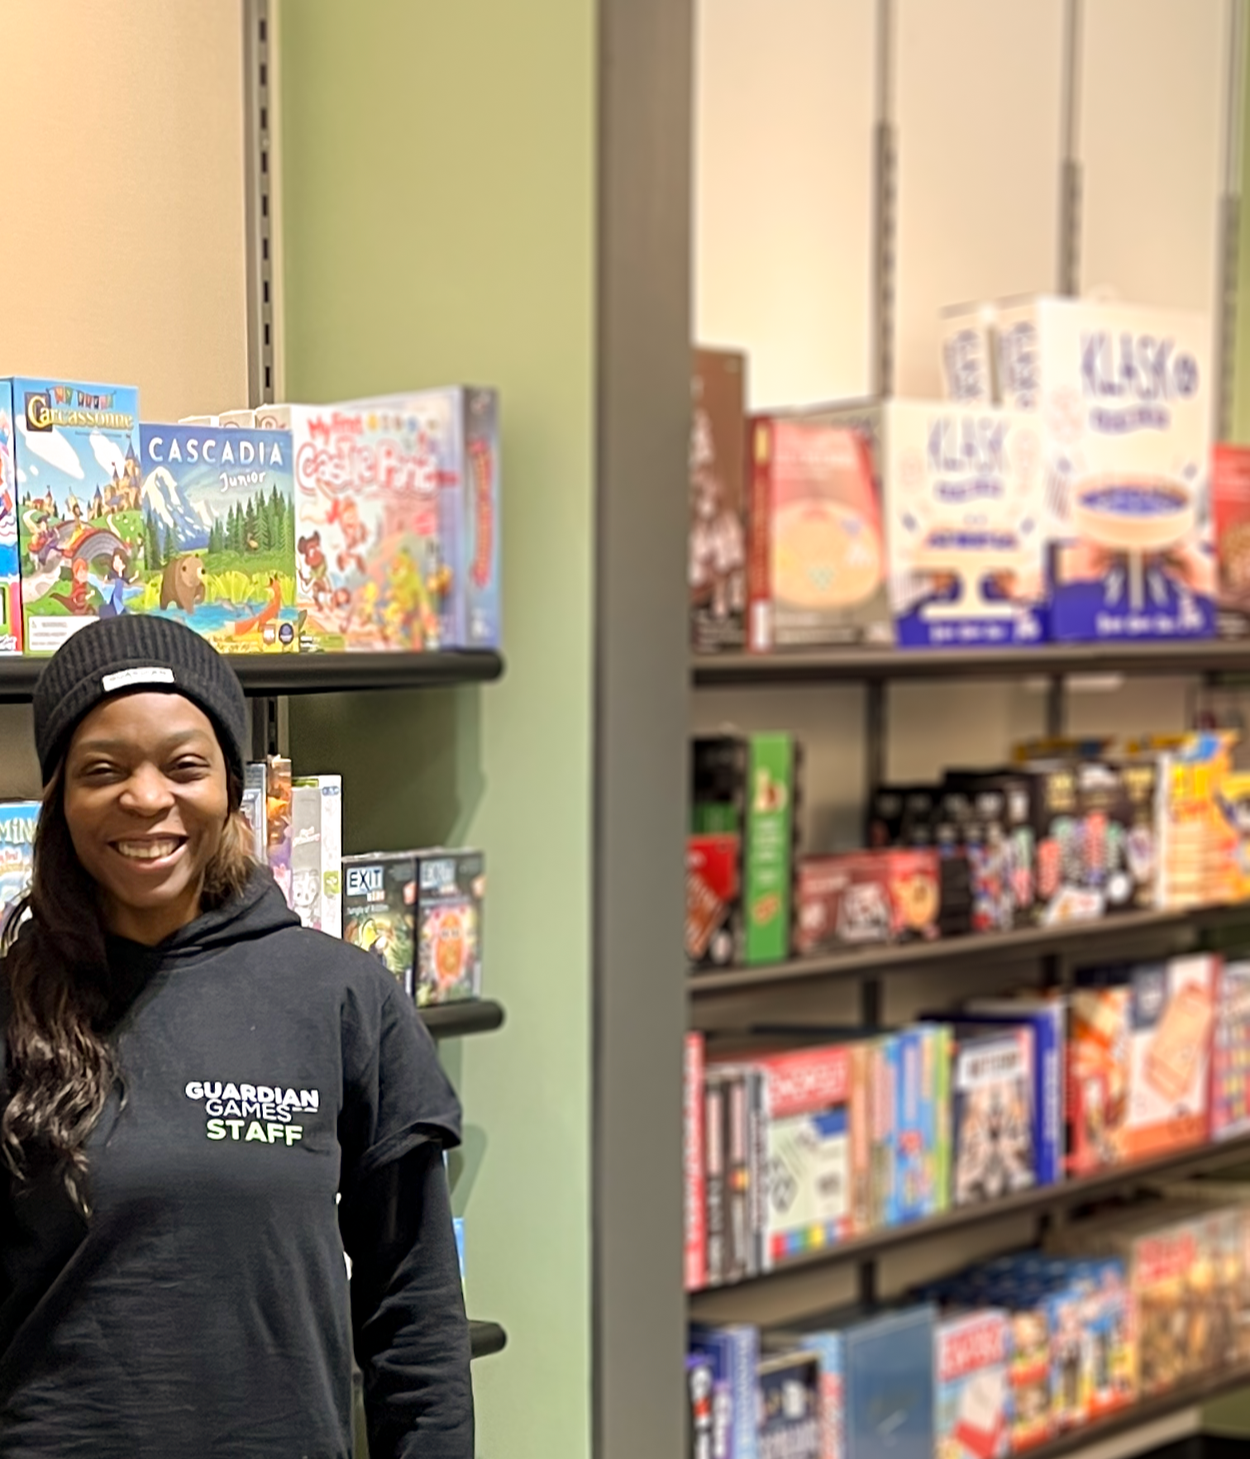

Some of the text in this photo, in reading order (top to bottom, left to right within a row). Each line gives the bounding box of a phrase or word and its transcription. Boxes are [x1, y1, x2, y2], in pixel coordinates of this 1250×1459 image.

[27, 394, 135, 431] Carcassonne
[148, 436, 284, 466] CASCADIA
[218, 469, 267, 493] Junior
[350, 868, 382, 891] EXIT
[185, 1081, 319, 1108] GUARDIAN
[205, 1098, 292, 1122] GAMES
[206, 1118, 303, 1146] STAFF
